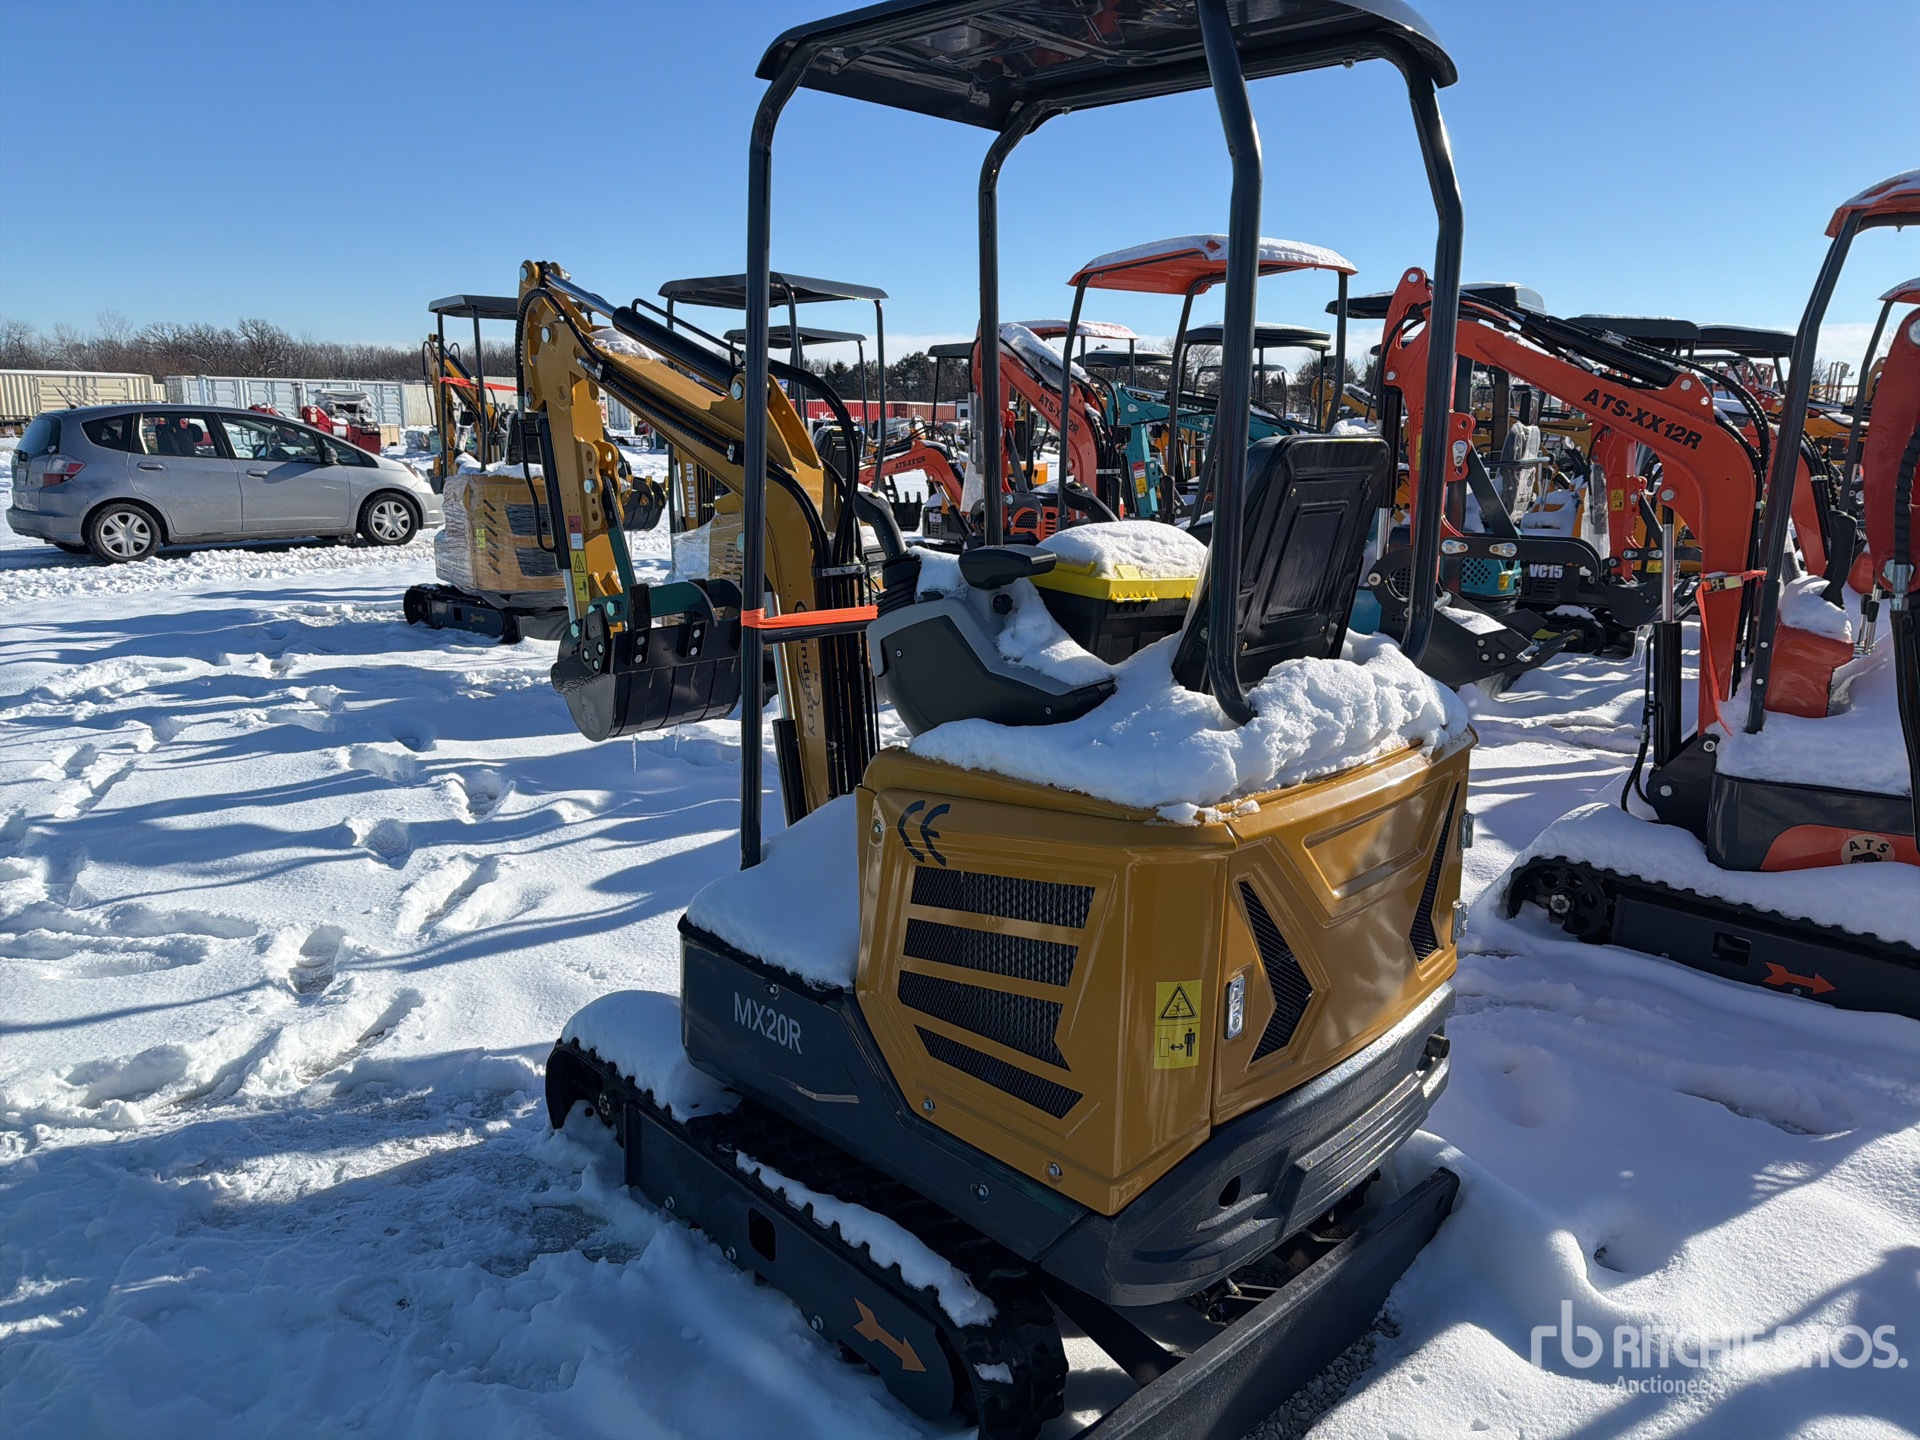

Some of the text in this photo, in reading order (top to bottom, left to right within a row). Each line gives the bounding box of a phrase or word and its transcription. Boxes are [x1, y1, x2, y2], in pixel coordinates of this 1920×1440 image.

[1582, 388, 1703, 450] ATS-XX12R
[1529, 563, 1564, 579] VC15
[1849, 838, 1890, 854] ATS
[734, 991, 803, 1055] MX20R
